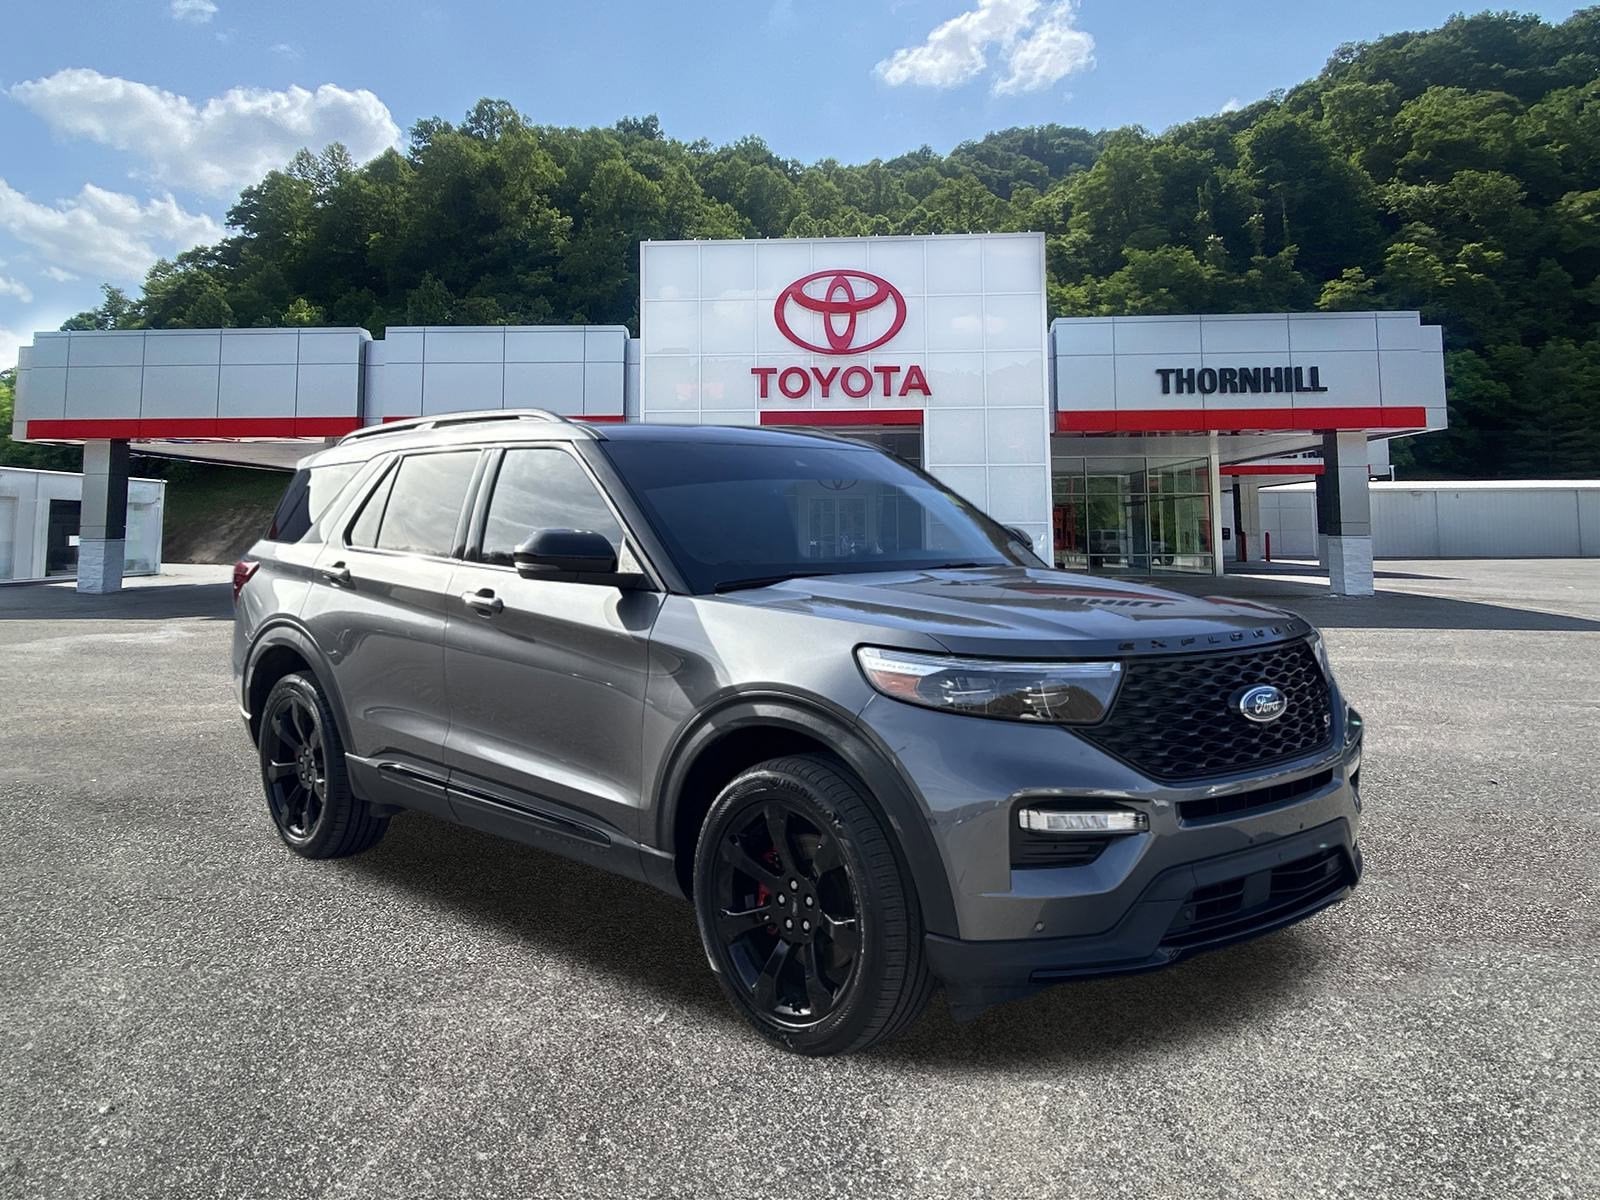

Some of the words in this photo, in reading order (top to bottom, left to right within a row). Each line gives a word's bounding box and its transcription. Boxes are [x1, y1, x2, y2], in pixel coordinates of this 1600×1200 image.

[751, 365, 932, 399] TOYOTA
[1155, 366, 1328, 394] THORNHILL
[1255, 694, 1282, 714] Ford
